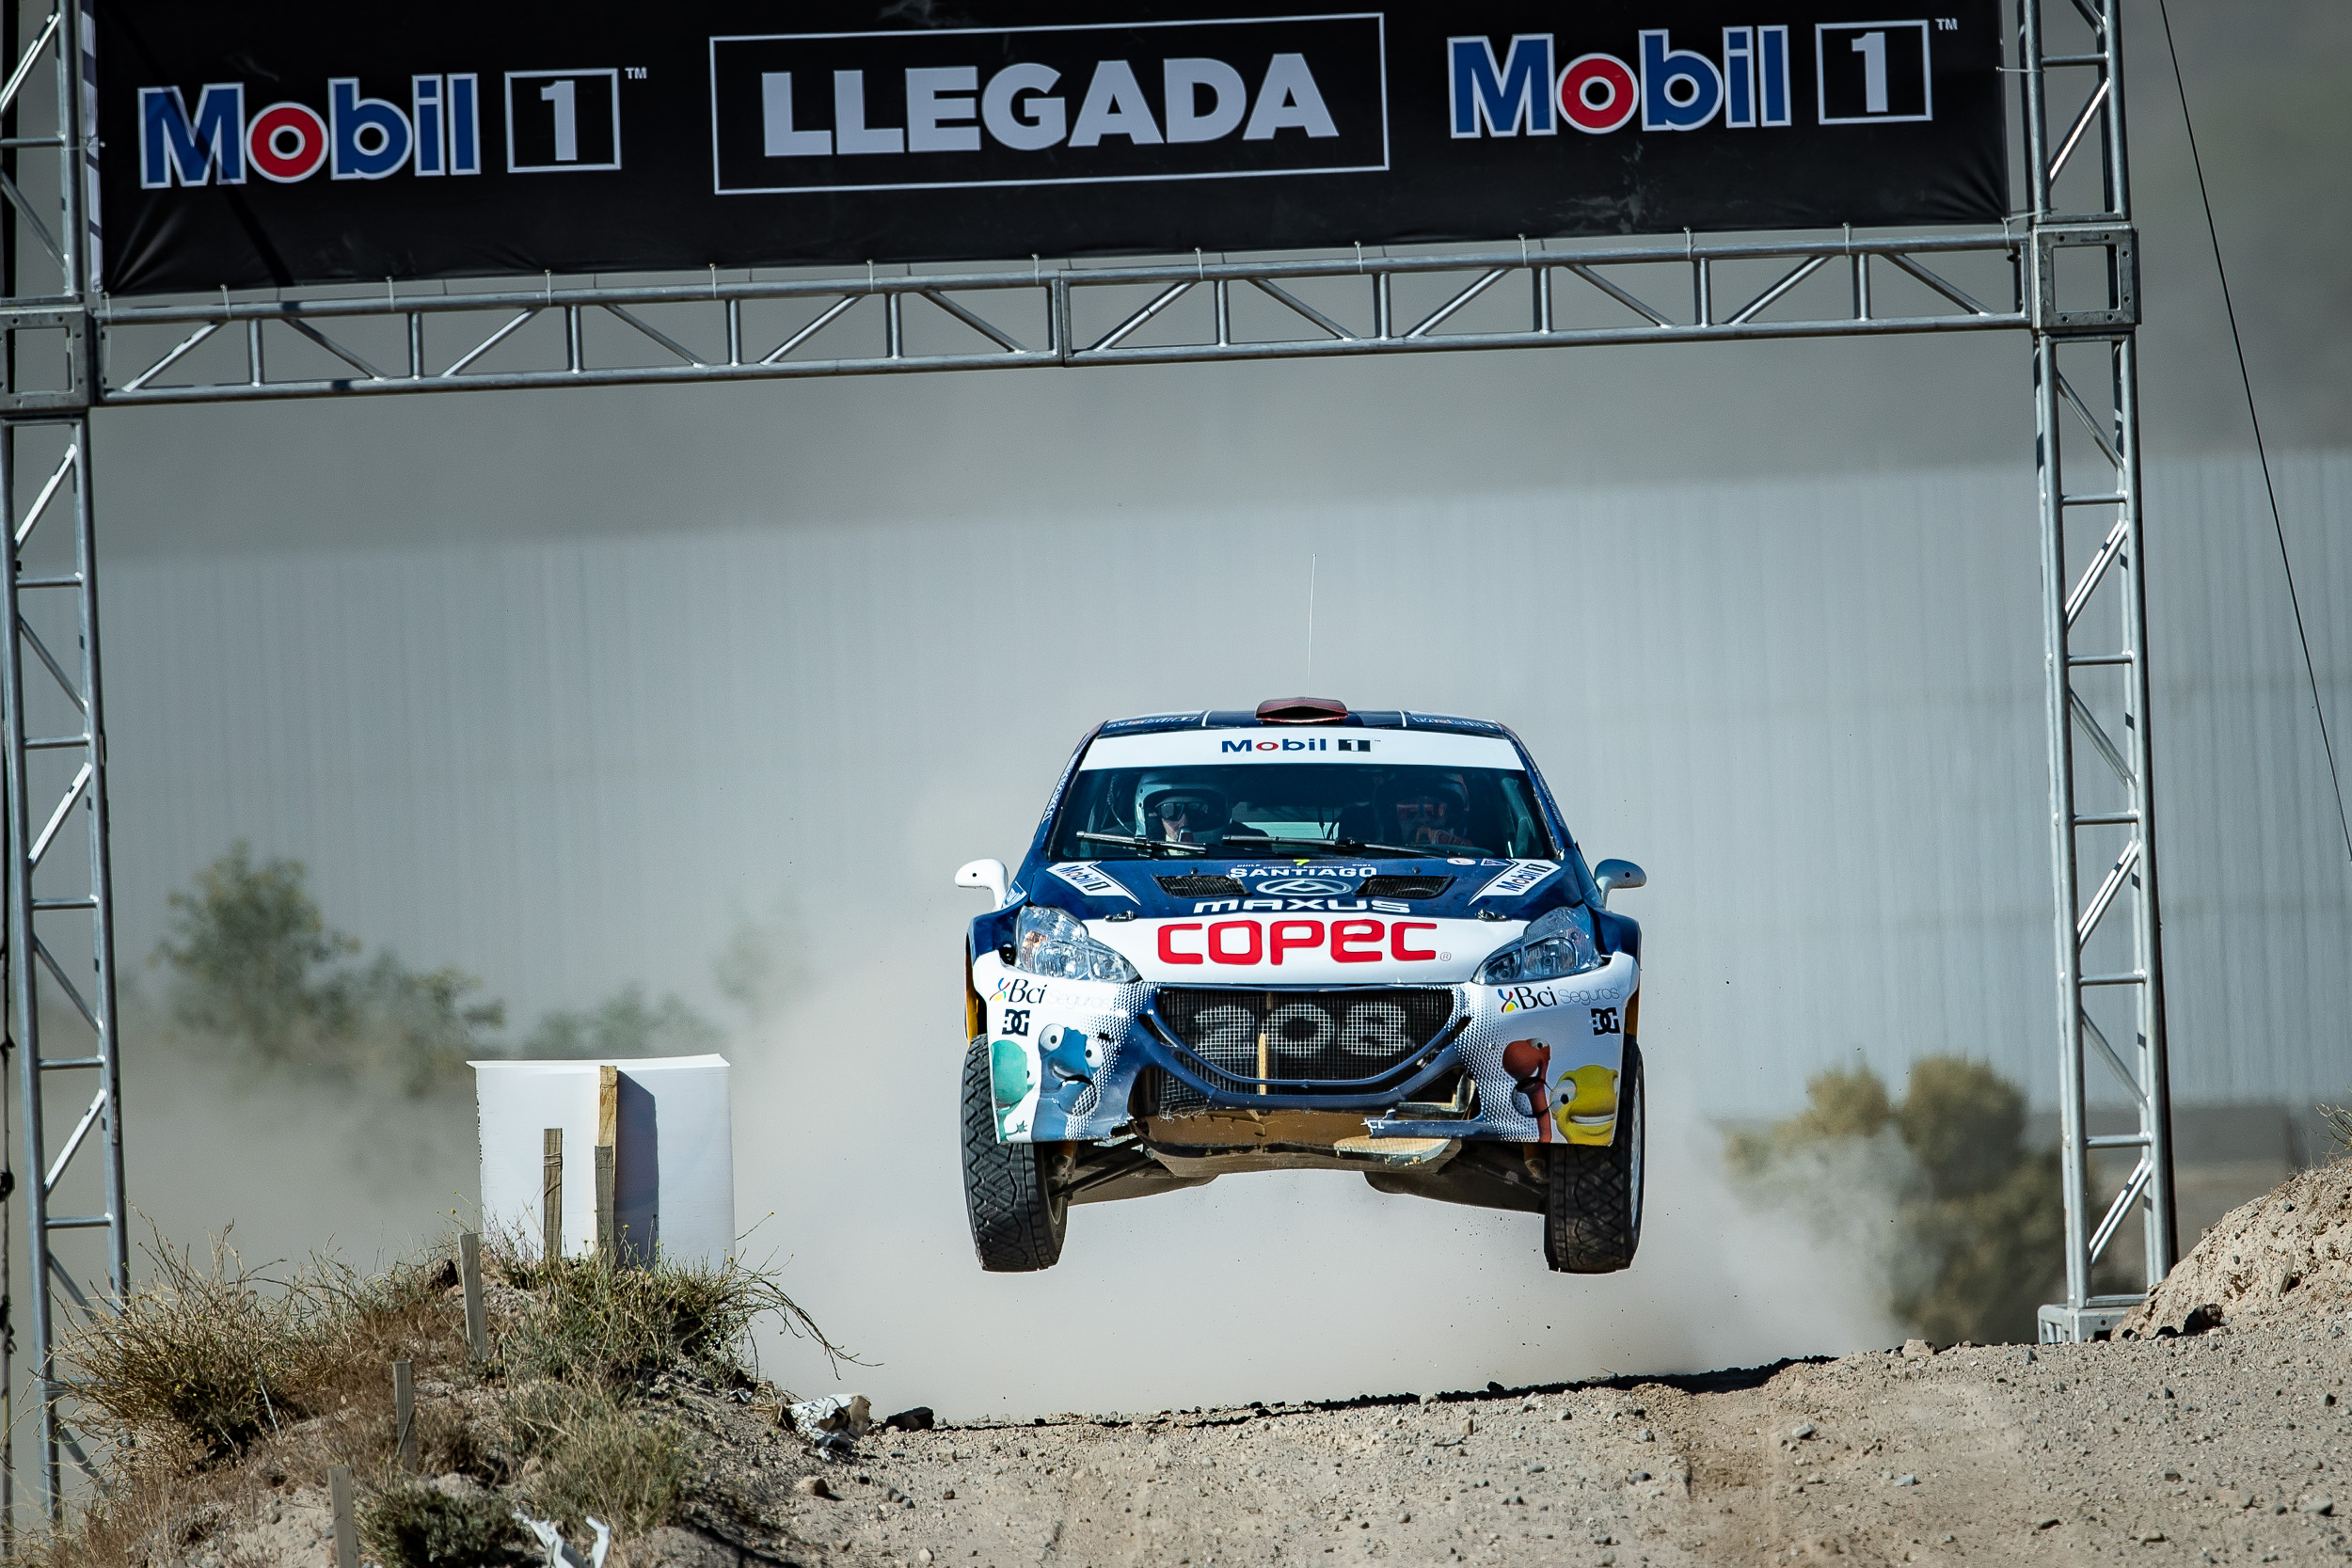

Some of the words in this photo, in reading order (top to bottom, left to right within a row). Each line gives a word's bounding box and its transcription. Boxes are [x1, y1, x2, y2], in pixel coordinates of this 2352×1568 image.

[1447, 24, 1791, 139] Mobil
[1851, 32, 1888, 113] 1
[1935, 19, 1958, 31] TM
[761, 53, 1340, 157] LLEGADA
[137, 73, 481, 189] Mobil
[541, 80, 577, 161] 1
[625, 67, 647, 80] TM
[1221, 738, 1327, 752] Mobil
[1056, 864, 1102, 885] Mobil
[1230, 866, 1377, 878] SANTIAGO
[1496, 868, 1543, 892] Mobil
[1193, 898, 1410, 914] MAXUS
[1008, 978, 1048, 1004] Bci
[1514, 986, 1558, 1010] Bci
[1558, 987, 1620, 1006] Seguros
[1193, 1002, 1406, 1059] 208
